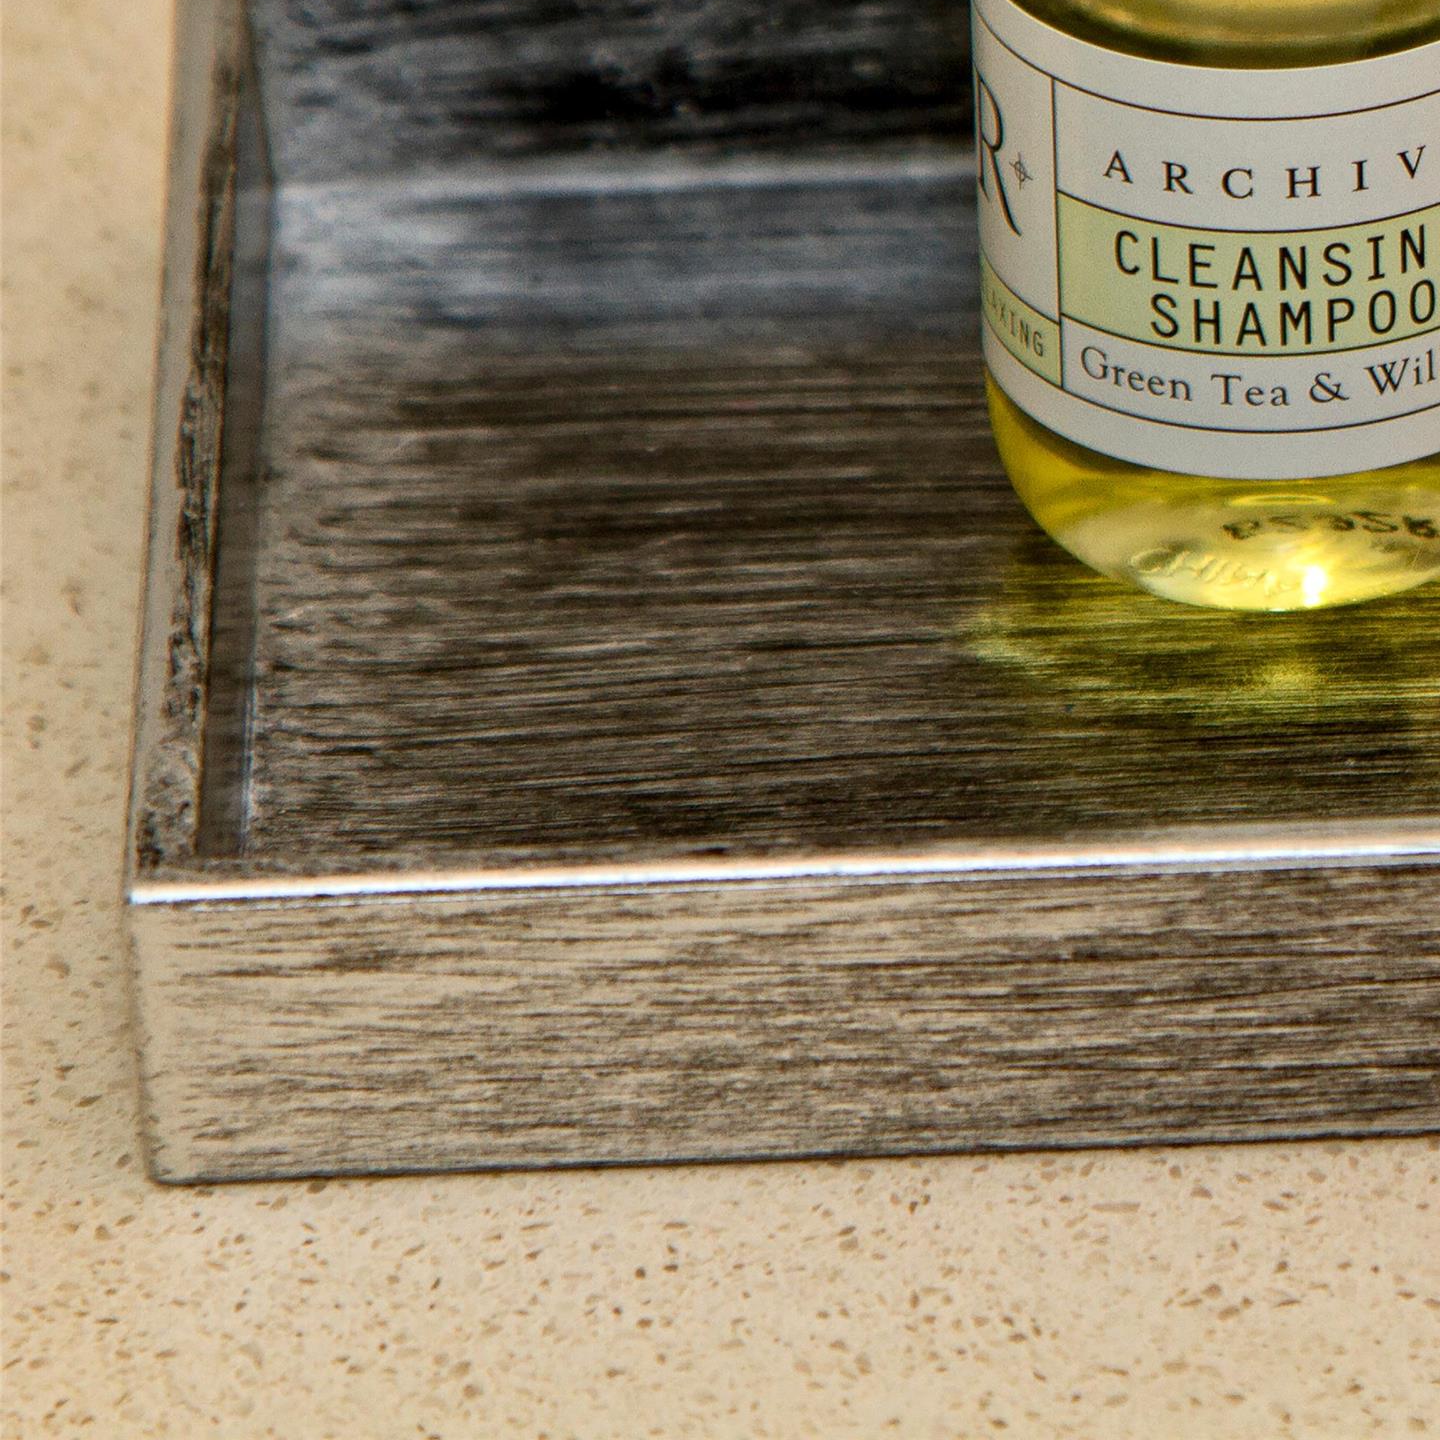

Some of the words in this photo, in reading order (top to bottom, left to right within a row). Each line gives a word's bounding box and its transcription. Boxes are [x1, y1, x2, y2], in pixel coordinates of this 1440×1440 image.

[975, 69, 1022, 237] R
[1151, 280, 1437, 346] SHAMPOO
[1080, 345, 1192, 402] Green
[1211, 374, 1289, 407] Tea
[1309, 372, 1349, 404] &
